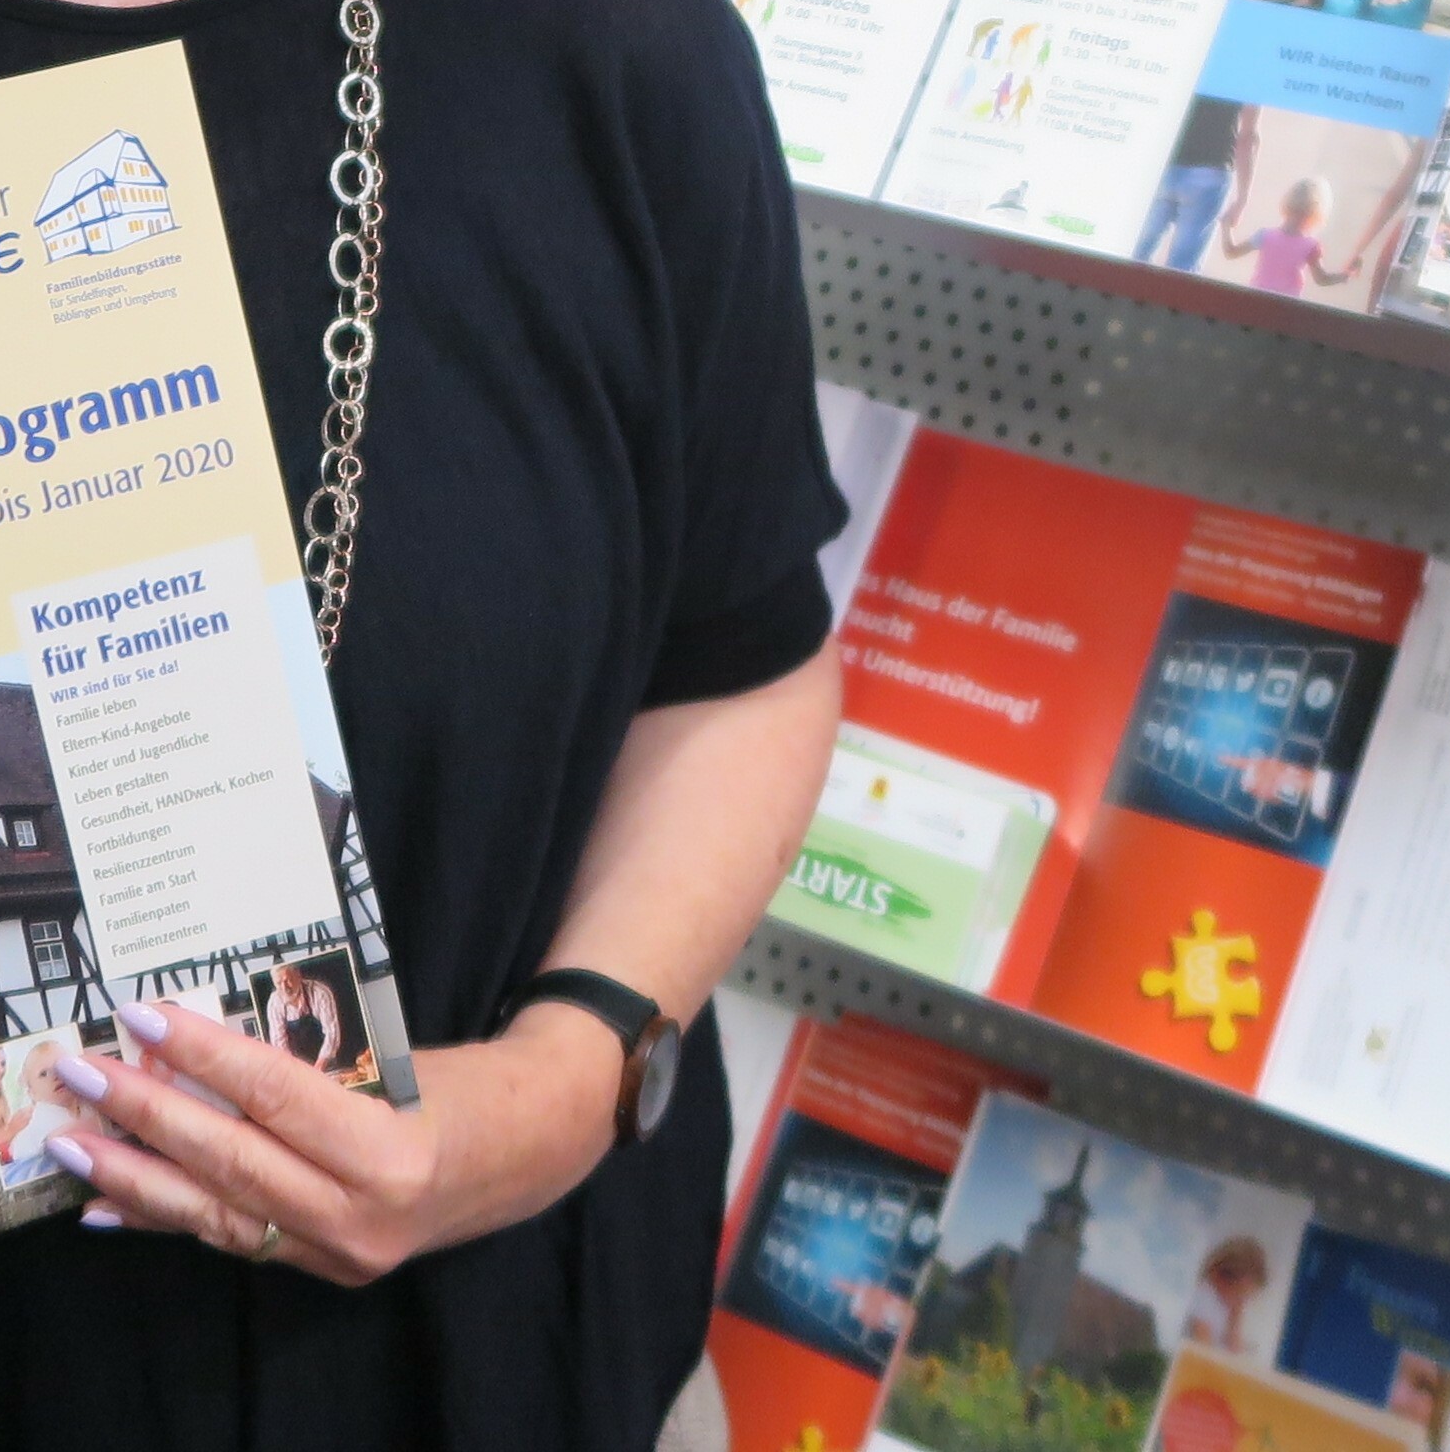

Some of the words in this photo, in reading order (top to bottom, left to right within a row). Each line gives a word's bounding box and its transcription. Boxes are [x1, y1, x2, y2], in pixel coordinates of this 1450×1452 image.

[1068, 28, 1130, 53] freitags
[1279, 46, 1314, 65] WIR
[1318, 54, 1374, 76] bieten
[1379, 65, 1431, 87] Raum
[1283, 78, 1320, 92] zum
[1326, 84, 1405, 110] Wachsen
[46, 252, 183, 294] Familienbildungsstätte
[49, 296, 64, 310] für
[66, 283, 128, 306] Sindelfingen,
[53, 303, 102, 325] Böblingen
[103, 297, 123, 313] und
[125, 287, 178, 309] Umgebung
[40, 462, 145, 516] Januar
[155, 436, 235, 486] 2020
[29, 568, 207, 634] Kompetenz
[885, 576, 942, 610] Haus
[946, 597, 989, 625] der
[991, 608, 1078, 654] Familie
[41, 643, 88, 679] für
[95, 610, 231, 664] Familien
[49, 686, 79, 705] WIR
[82, 676, 110, 697] sind
[112, 672, 132, 690] für
[135, 666, 155, 683] Sie
[159, 659, 181, 677] da!
[863, 646, 1042, 725] Unterstützung!
[55, 705, 101, 728] Familie
[102, 697, 137, 716] leben
[61, 709, 192, 754] Eltern-Kind-Angebote
[67, 757, 109, 780] Kinder
[112, 749, 136, 767] und
[138, 730, 211, 761] Jugendliche
[74, 785, 112, 806] Leben
[115, 769, 170, 797] gestalten
[80, 801, 154, 831] Gesundheit,
[155, 780, 227, 811] HANDwerk,
[228, 767, 275, 791] Kochen
[86, 822, 173, 857] Fortbildungen
[92, 843, 197, 882] Resilienzzentrum
[99, 884, 144, 907] Familie
[146, 879, 167, 895] am
[168, 868, 199, 887] Start
[785, 855, 893, 916] START
[105, 899, 191, 932] Familienpaten
[111, 921, 209, 958] Familienzentren
